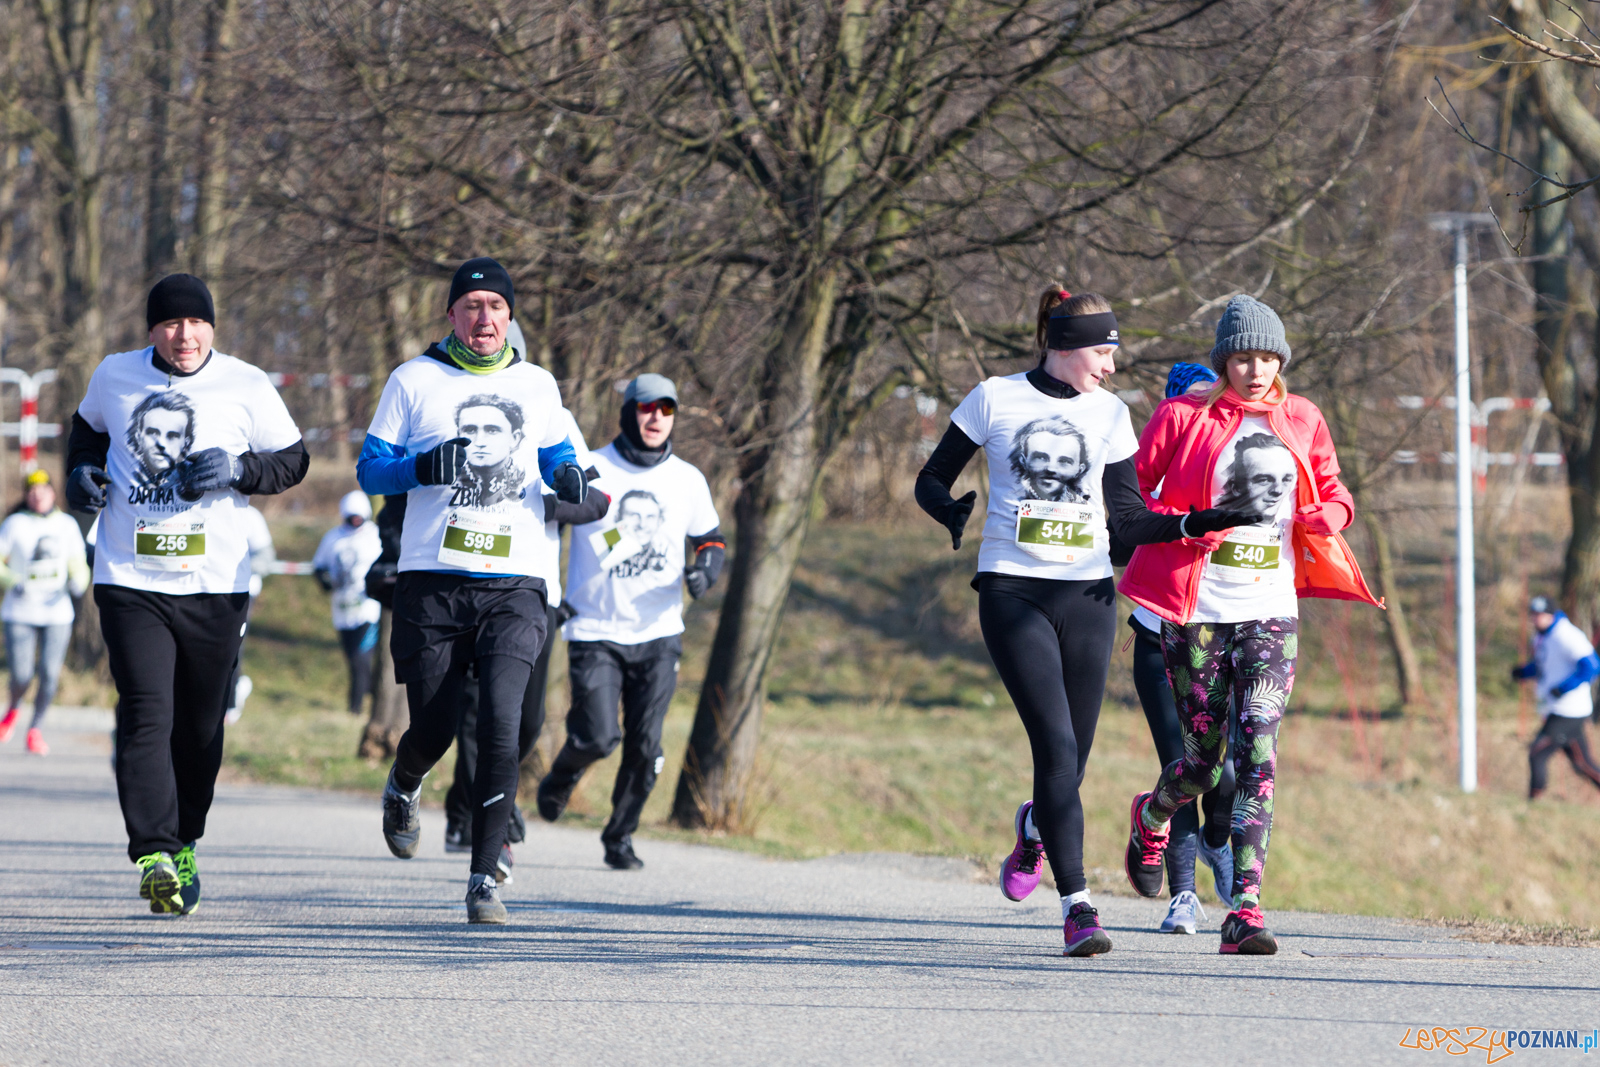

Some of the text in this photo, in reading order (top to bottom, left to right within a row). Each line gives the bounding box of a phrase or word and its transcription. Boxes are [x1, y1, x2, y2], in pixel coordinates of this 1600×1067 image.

[1041, 521, 1074, 540] 541
[156, 535, 188, 551] 256
[464, 531, 495, 550] 598
[1233, 545, 1265, 563] 540
